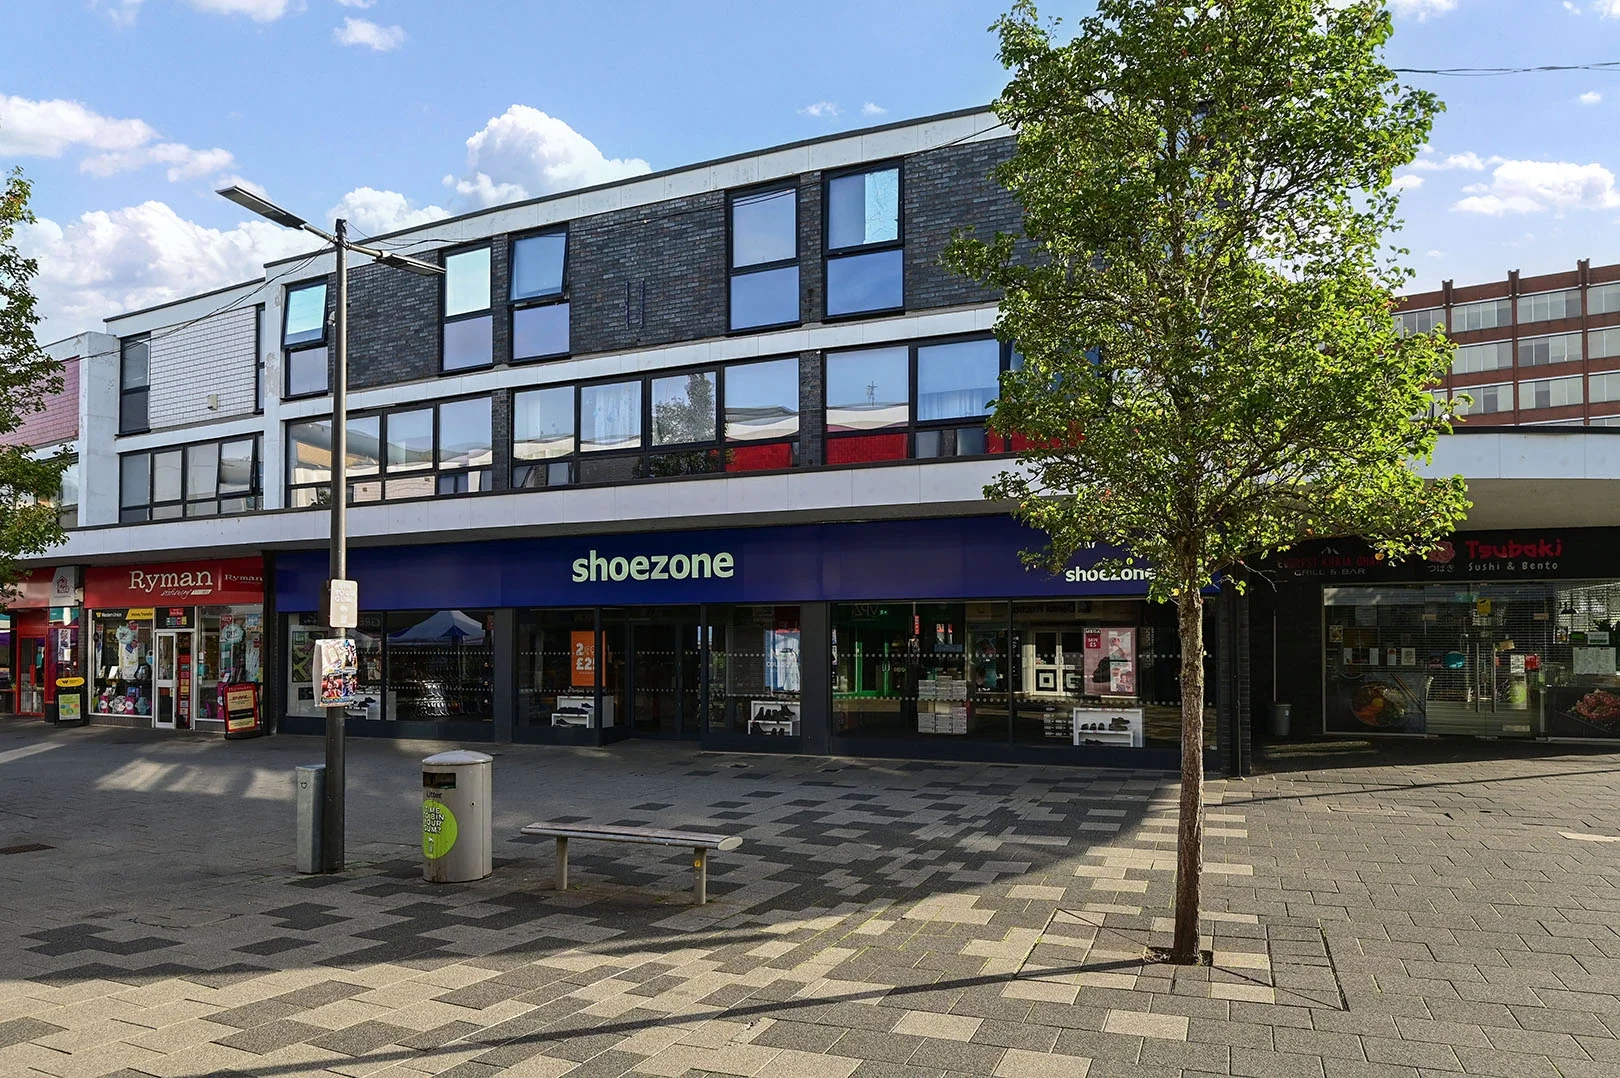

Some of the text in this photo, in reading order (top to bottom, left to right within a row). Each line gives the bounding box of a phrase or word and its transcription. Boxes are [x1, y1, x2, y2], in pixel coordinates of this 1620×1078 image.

[1465, 538, 1563, 560] Tsubaki
[572, 549, 735, 583] shoezone
[1294, 568, 1325, 577] GRILL
[1341, 567, 1366, 576] BAR
[1468, 560, 1558, 571] Sushi & Bento
[224, 573, 264, 583] Ryman
[1065, 565, 1157, 582] shoezone
[128, 570, 213, 593] Ryman
[575, 642, 584, 656] 2
[575, 657, 595, 671] £2
[430, 813, 445, 822] BIN
